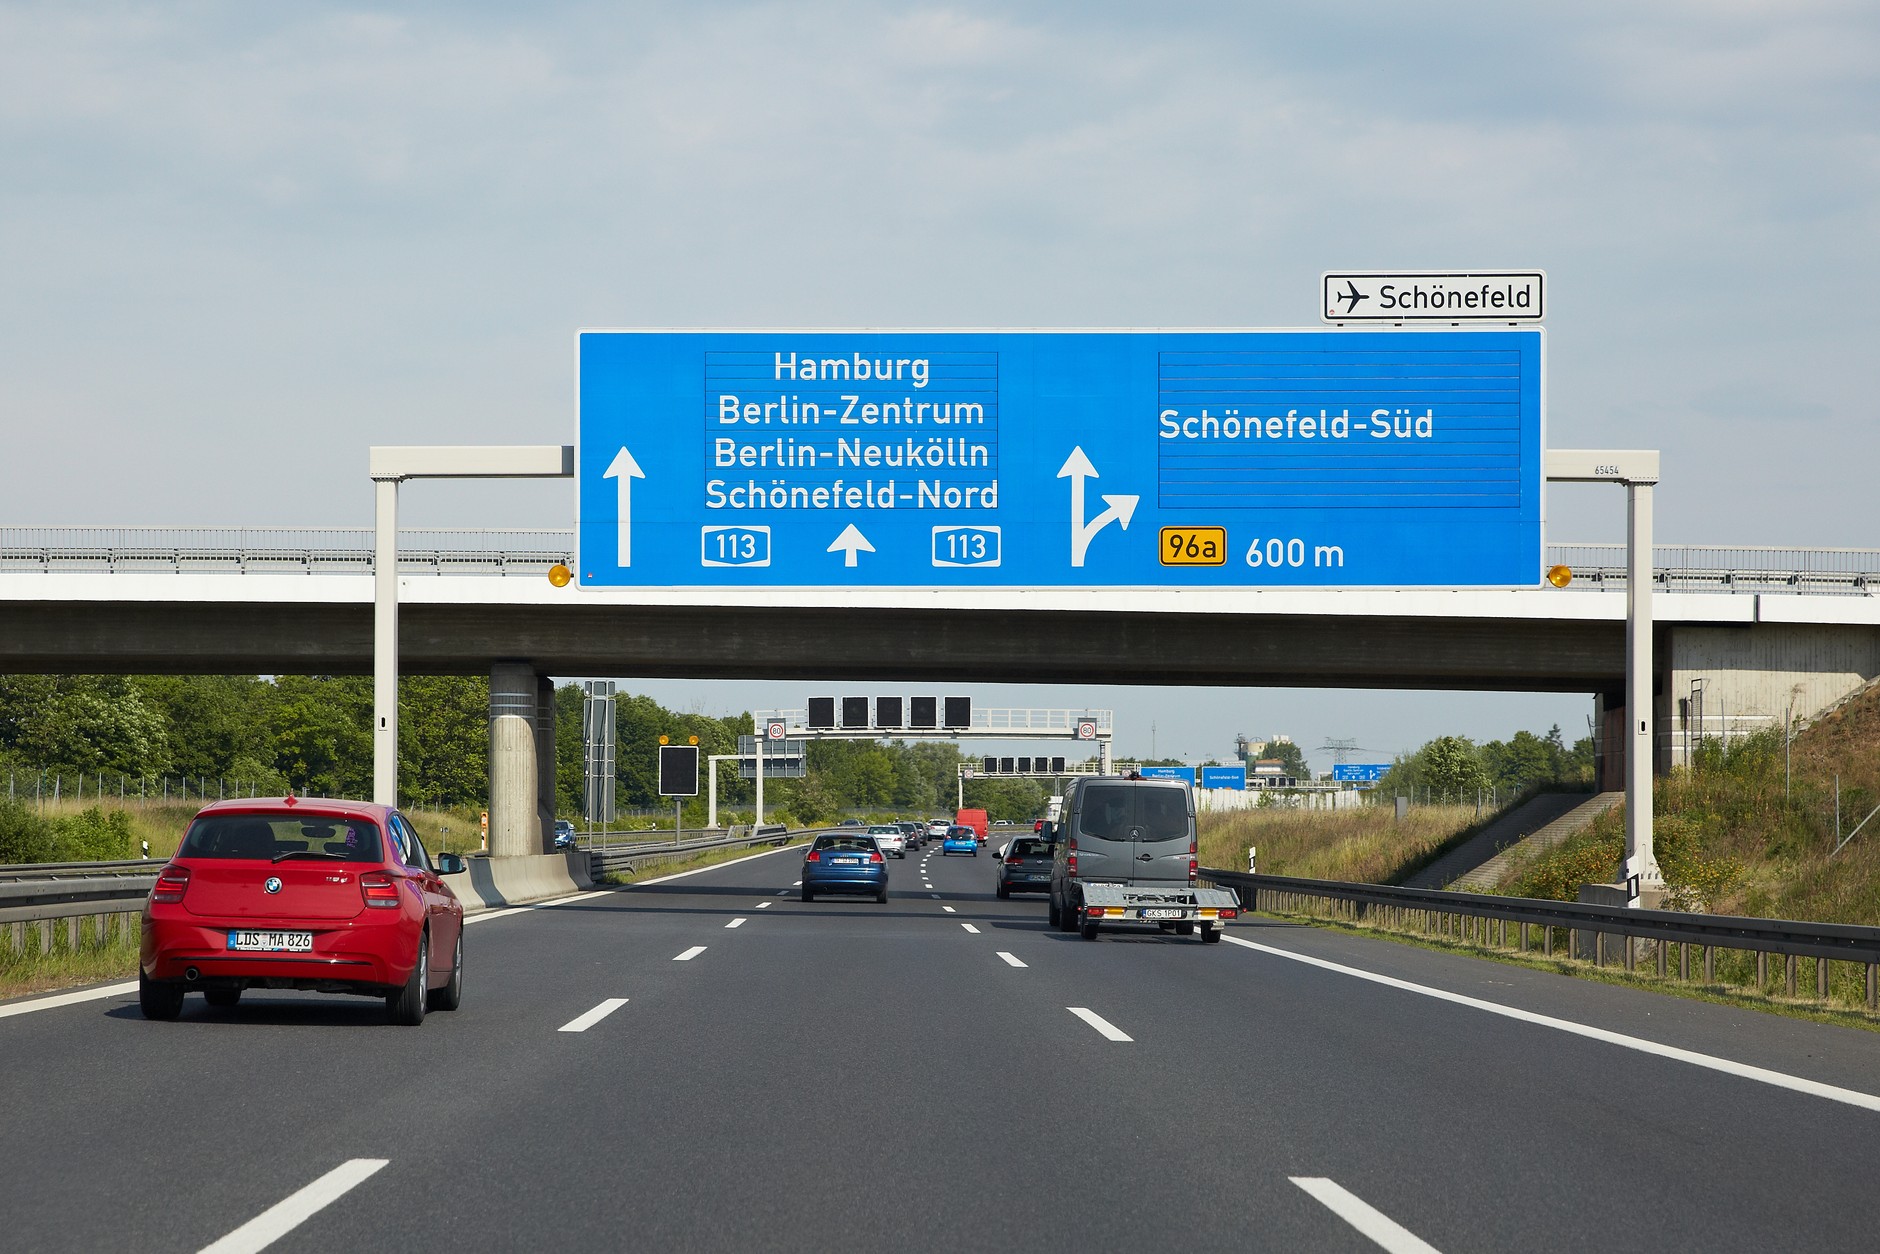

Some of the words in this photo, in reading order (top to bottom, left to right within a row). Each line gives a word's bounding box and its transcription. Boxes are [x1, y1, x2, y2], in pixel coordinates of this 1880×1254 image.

[1380, 285, 1530, 309] Schönefeld
[775, 353, 929, 388] Hamburg
[719, 396, 984, 424] Berlin-Zentrum
[1159, 409, 1433, 439] Schönefeld-Süd
[715, 438, 988, 467] Berlin-Neukölln
[1595, 466, 1619, 475] 65454
[706, 480, 998, 509] Schönefeld-Nord
[716, 534, 755, 559] 113
[947, 534, 986, 559] 113
[1169, 535, 1217, 559] 96a
[1246, 539, 1304, 567] 600
[1315, 546, 1344, 567] m
[772, 727, 781, 735] 80
[1082, 726, 1092, 734] 80
[1147, 909, 1162, 917] GKS
[236, 932, 260, 946] LDS
[269, 933, 284, 947] MA
[287, 933, 310, 947] 826
